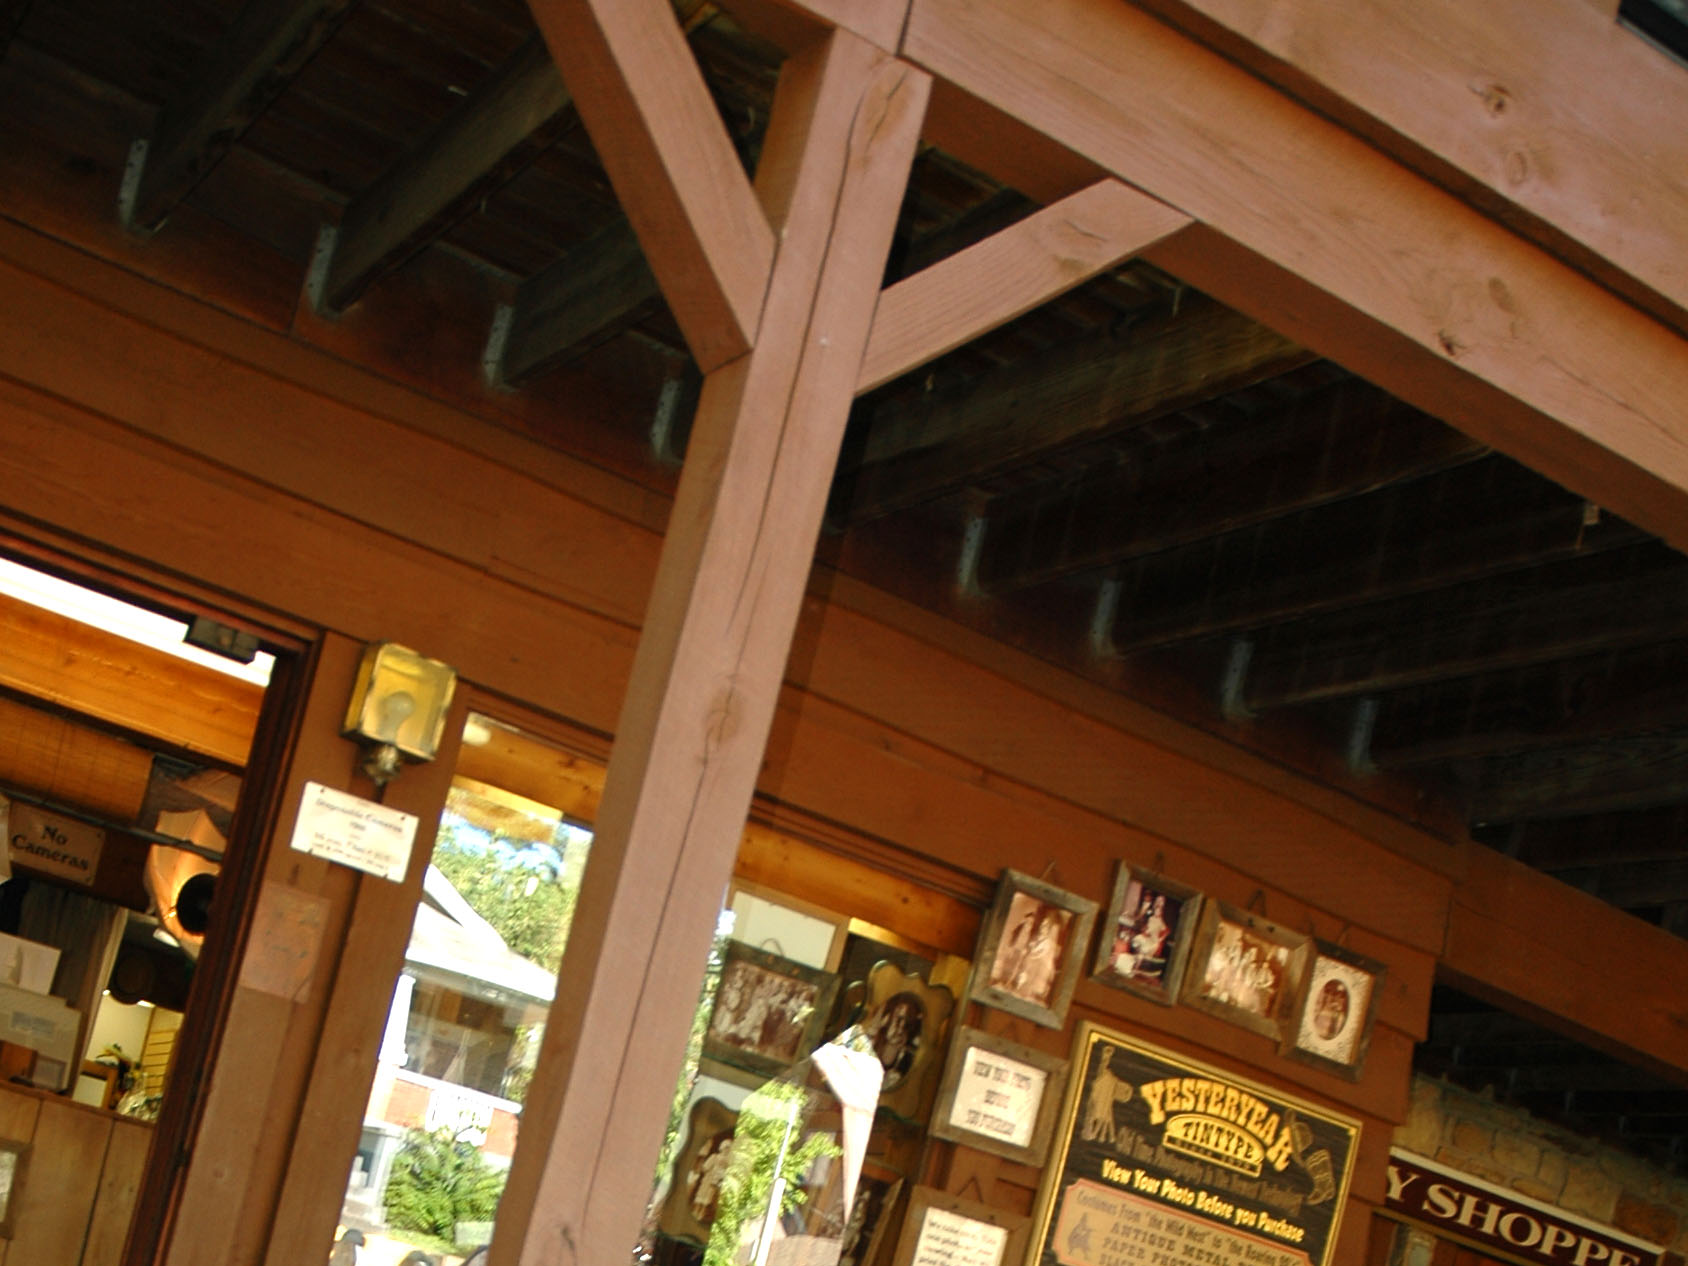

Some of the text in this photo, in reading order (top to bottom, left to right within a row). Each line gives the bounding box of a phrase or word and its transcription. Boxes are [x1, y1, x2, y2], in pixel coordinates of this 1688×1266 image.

[12, 833, 88, 870] Cameras
[42, 825, 68, 846] No
[1140, 1077, 1293, 1172] YESTERYEAR
[1182, 1119, 1254, 1159] TINTYPE
[1102, 1159, 1132, 1184] View
[1133, 1169, 1161, 1194] Your
[1160, 1179, 1195, 1206] Photo
[1195, 1191, 1234, 1219] Before
[1257, 1212, 1304, 1242] Purchase
[1103, 1237, 1145, 1260] PAPER
[1111, 1222, 1176, 1252] ANTIQUE
